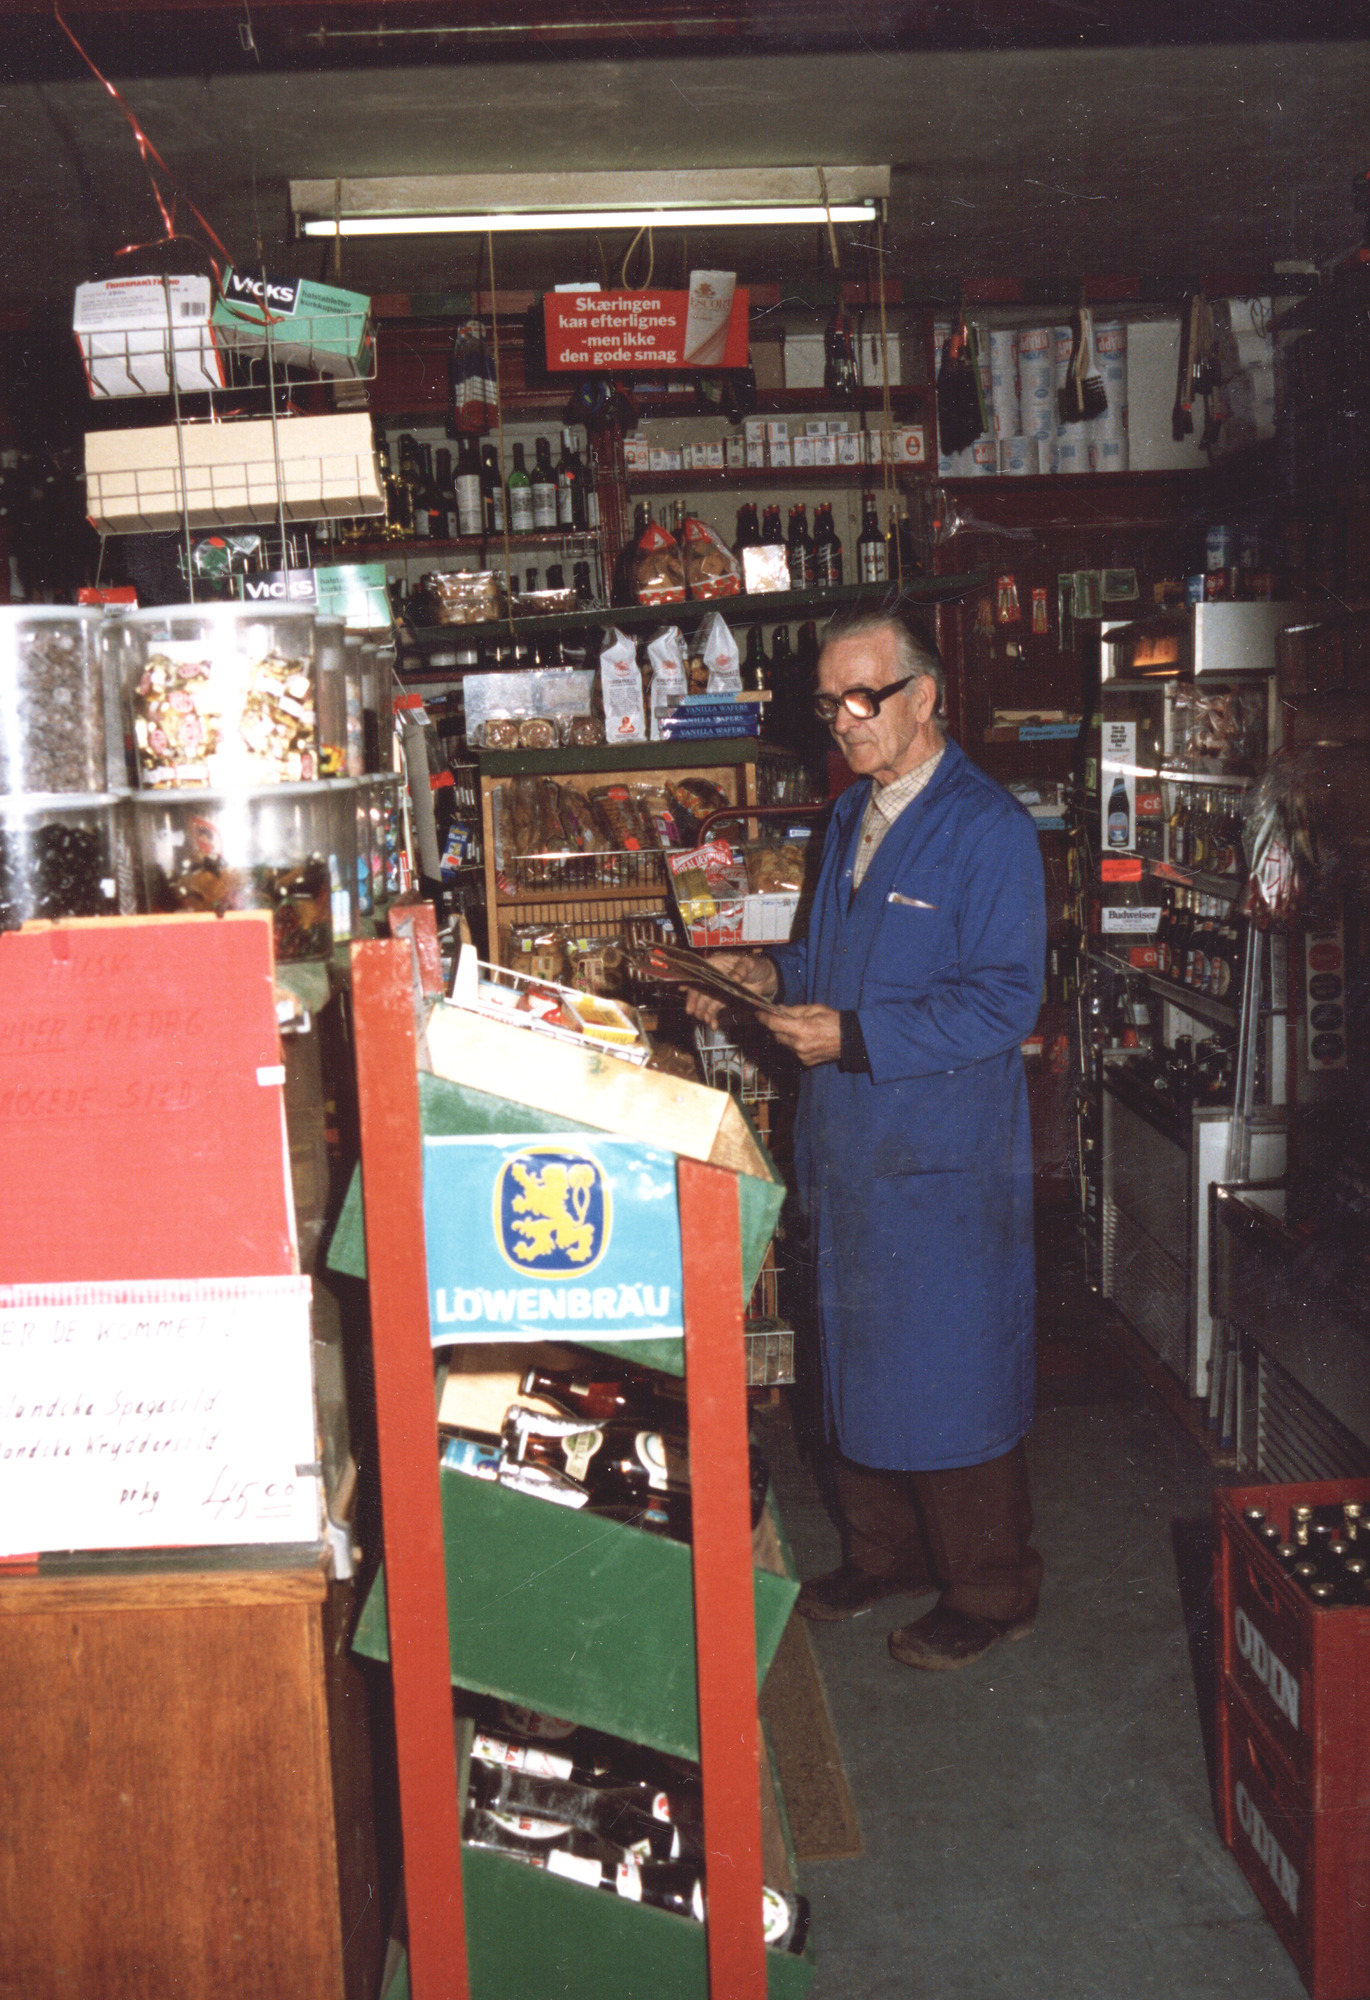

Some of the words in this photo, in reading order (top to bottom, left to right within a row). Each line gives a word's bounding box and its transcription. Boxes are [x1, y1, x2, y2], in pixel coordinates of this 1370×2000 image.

[232, 274, 295, 302] VICKS
[575, 296, 661, 314] Skæringen
[558, 314, 588, 329] kan
[590, 314, 677, 330] efterlignes
[581, 335, 621, 347] -men
[622, 332, 656, 346] ikke
[559, 349, 589, 363] den
[593, 347, 632, 365] gode
[634, 350, 678, 364] smag
[246, 580, 315, 600] VICKS
[719, 704, 749, 712] WAFERS
[680, 729, 713, 737] VANILLA
[715, 727, 746, 735] WAFERS
[1108, 910, 1157, 920] Budweiser
[436, 1283, 670, 1323] LÖWENBRÄU
[52, 1319, 79, 1344] DE
[1234, 1605, 1299, 1732] ODIN
[1234, 1780, 1299, 1919] ODIN
